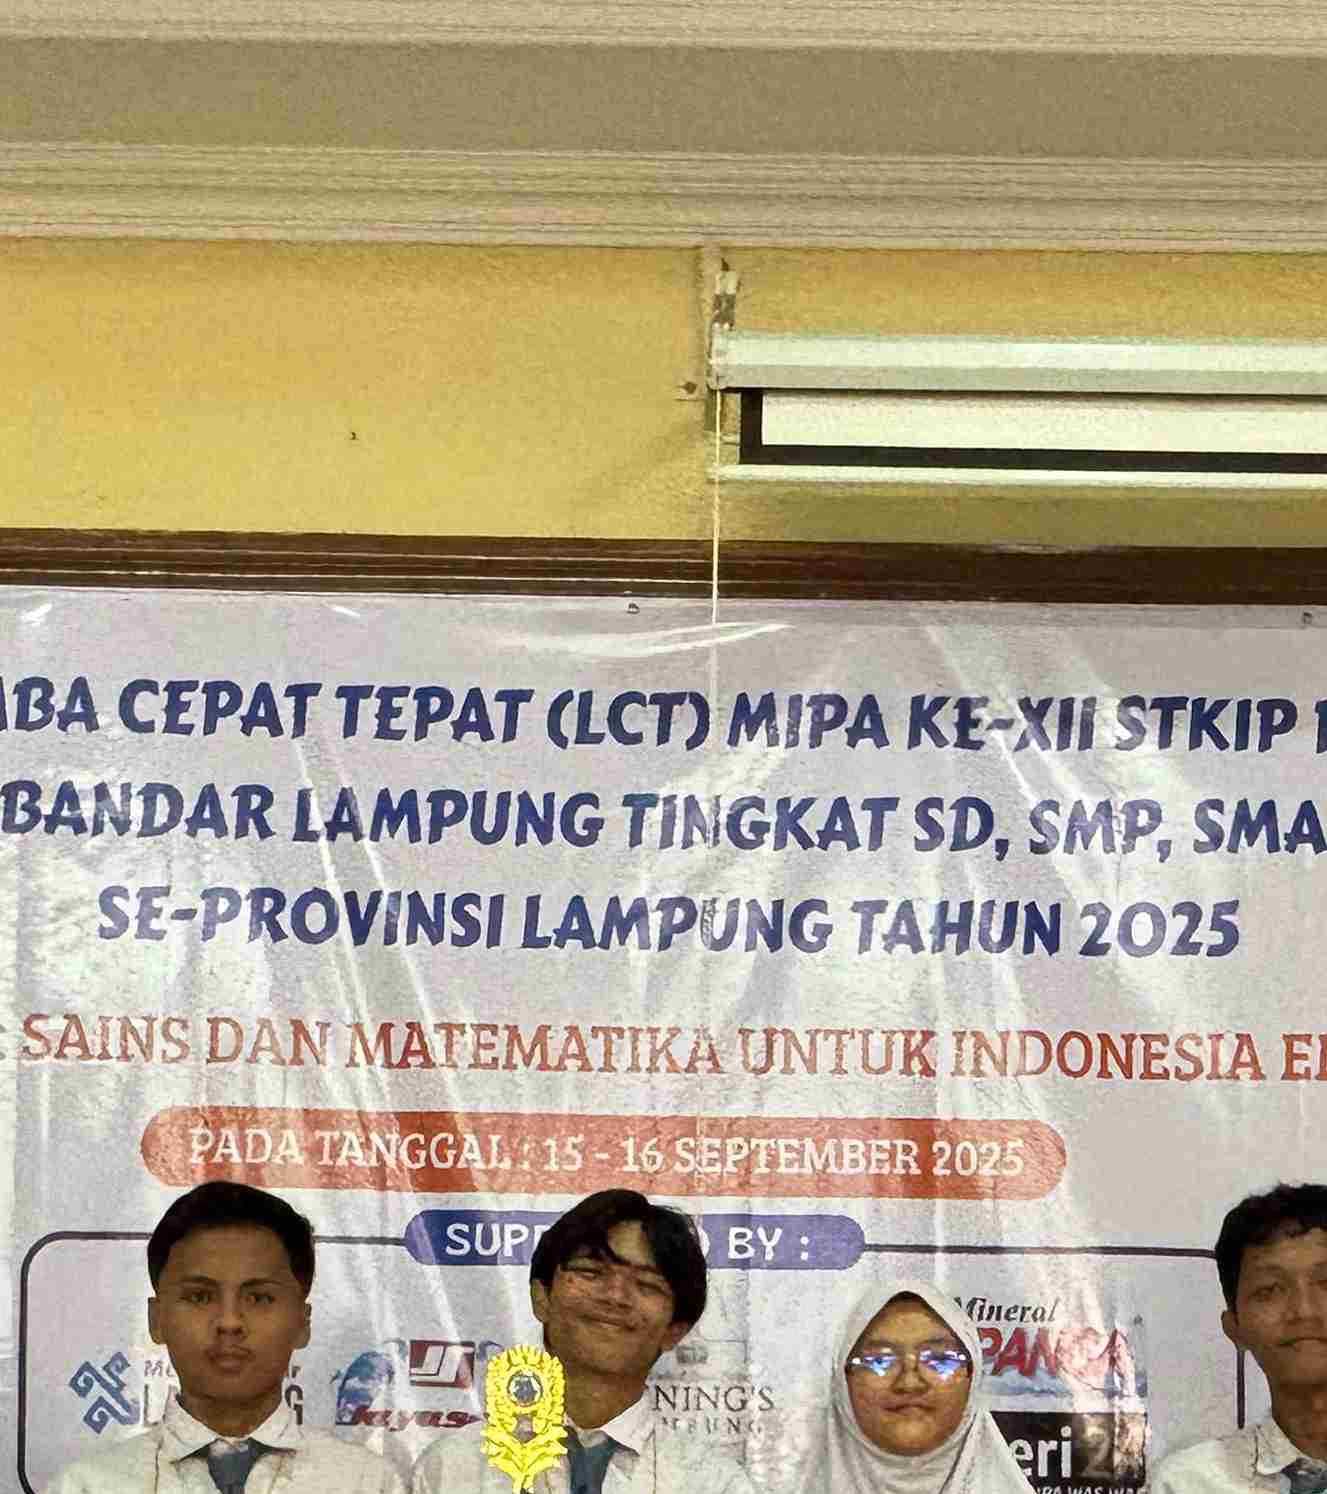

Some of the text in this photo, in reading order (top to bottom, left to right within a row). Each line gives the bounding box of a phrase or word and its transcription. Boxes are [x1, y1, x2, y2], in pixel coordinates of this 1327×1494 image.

[118, 677, 322, 739] CEPAT
[334, 684, 534, 743] TEPAT
[546, 688, 710, 750] (LCT)
[727, 691, 888, 750] MIPA
[907, 693, 1095, 752] KE-XII
[1115, 694, 1299, 753] STKIP
[0, 779, 277, 839] BANDAR
[292, 787, 604, 849] LAMPUNG
[624, 793, 898, 853] TINGKAT
[914, 797, 1008, 862] SD,
[1028, 798, 1171, 862] SMP,
[97, 884, 1241, 958] SE-PROVINSI LAMPUNG TAHUN 2025
[22, 1013, 192, 1065] SAINS
[206, 1017, 332, 1067] DAN
[344, 1020, 723, 1075] MATEMATIKA
[740, 1028, 936, 1079] UNTUK
[951, 1030, 1263, 1082] INDONESIA
[190, 1127, 301, 1166] PADA
[543, 1136, 581, 1171] 15
[619, 1136, 659, 1172] 16
[675, 1138, 919, 1175] SEPTEMBER
[933, 1140, 1025, 1176] 2025
[727, 1228, 784, 1259] BY
